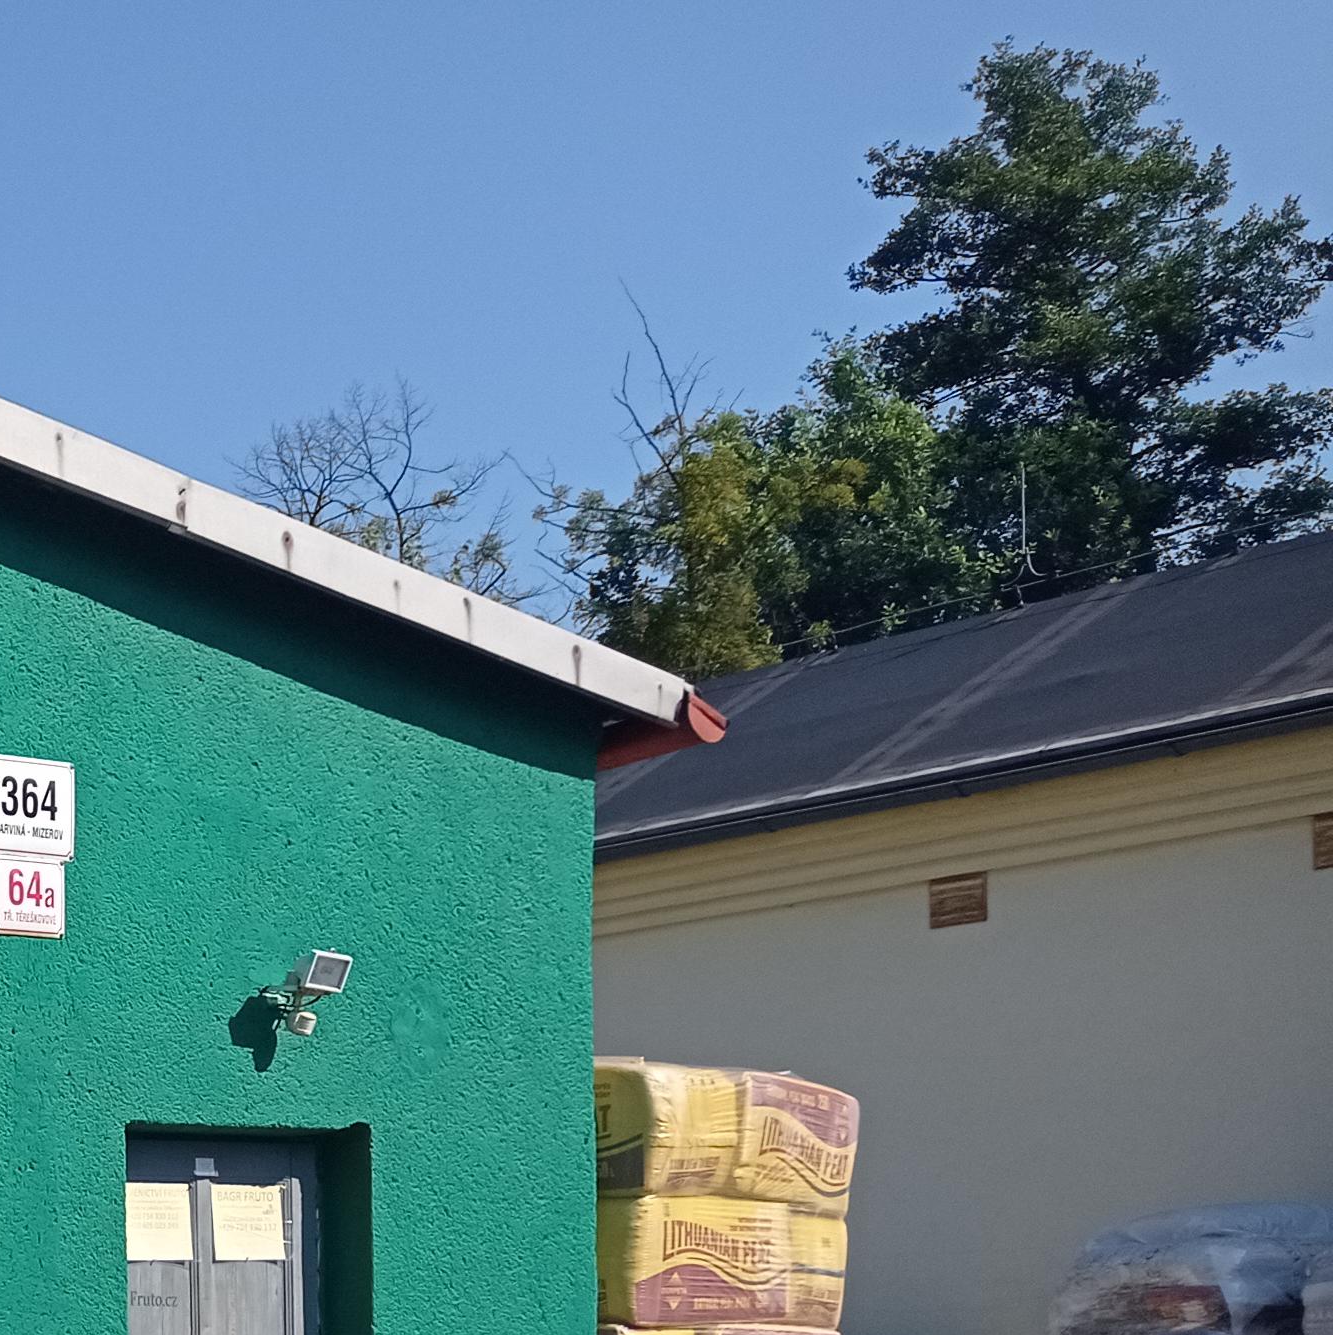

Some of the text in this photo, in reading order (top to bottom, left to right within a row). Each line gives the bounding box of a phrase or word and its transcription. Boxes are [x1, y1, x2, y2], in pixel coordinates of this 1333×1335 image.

[1, 776, 57, 821] 364
[32, 826, 64, 840] MIZEROV
[8, 868, 55, 908] 64a
[244, 1191, 274, 1202] FRUTO
[130, 1290, 178, 1307] Fruto.cz
